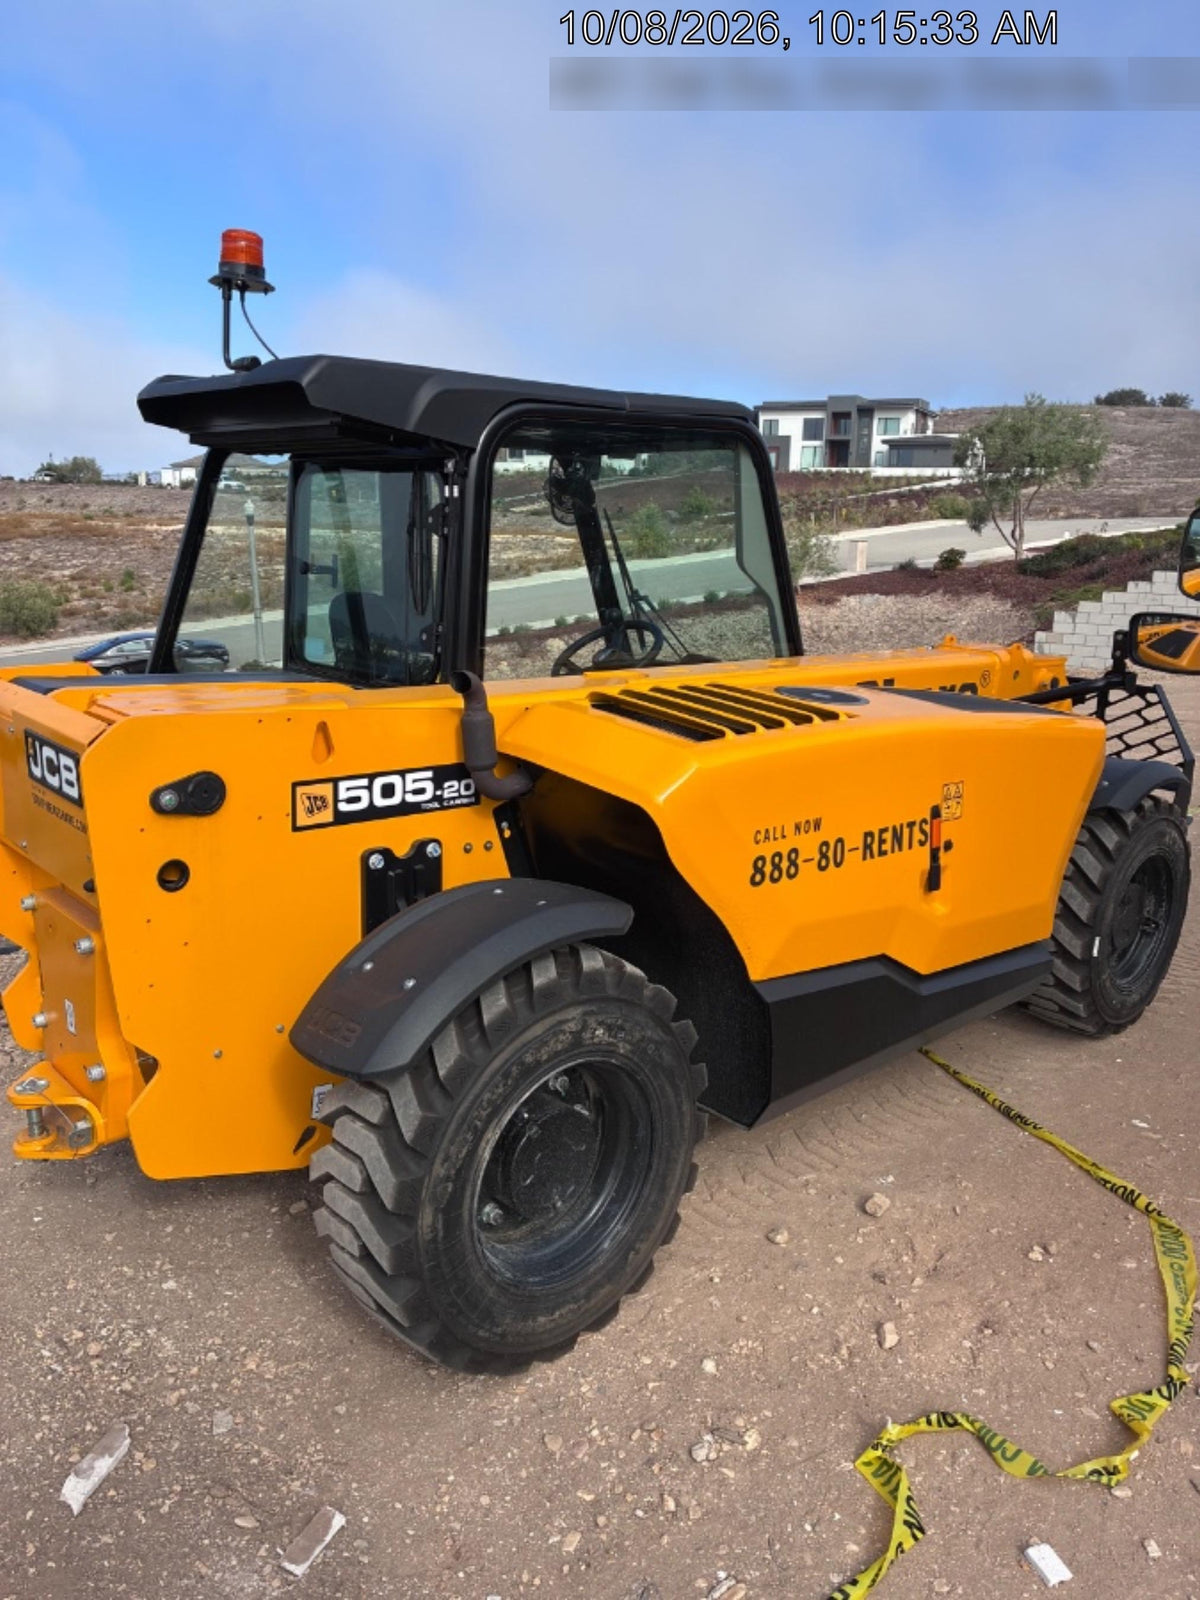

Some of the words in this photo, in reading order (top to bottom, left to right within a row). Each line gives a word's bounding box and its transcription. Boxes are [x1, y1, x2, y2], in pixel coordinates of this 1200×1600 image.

[27, 736, 80, 800] JCB
[301, 793, 330, 818] JCB
[337, 770, 476, 812] 505-20
[753, 824, 787, 845] CALL
[794, 816, 823, 836] NOW
[749, 816, 929, 888] 888-80-RENTS
